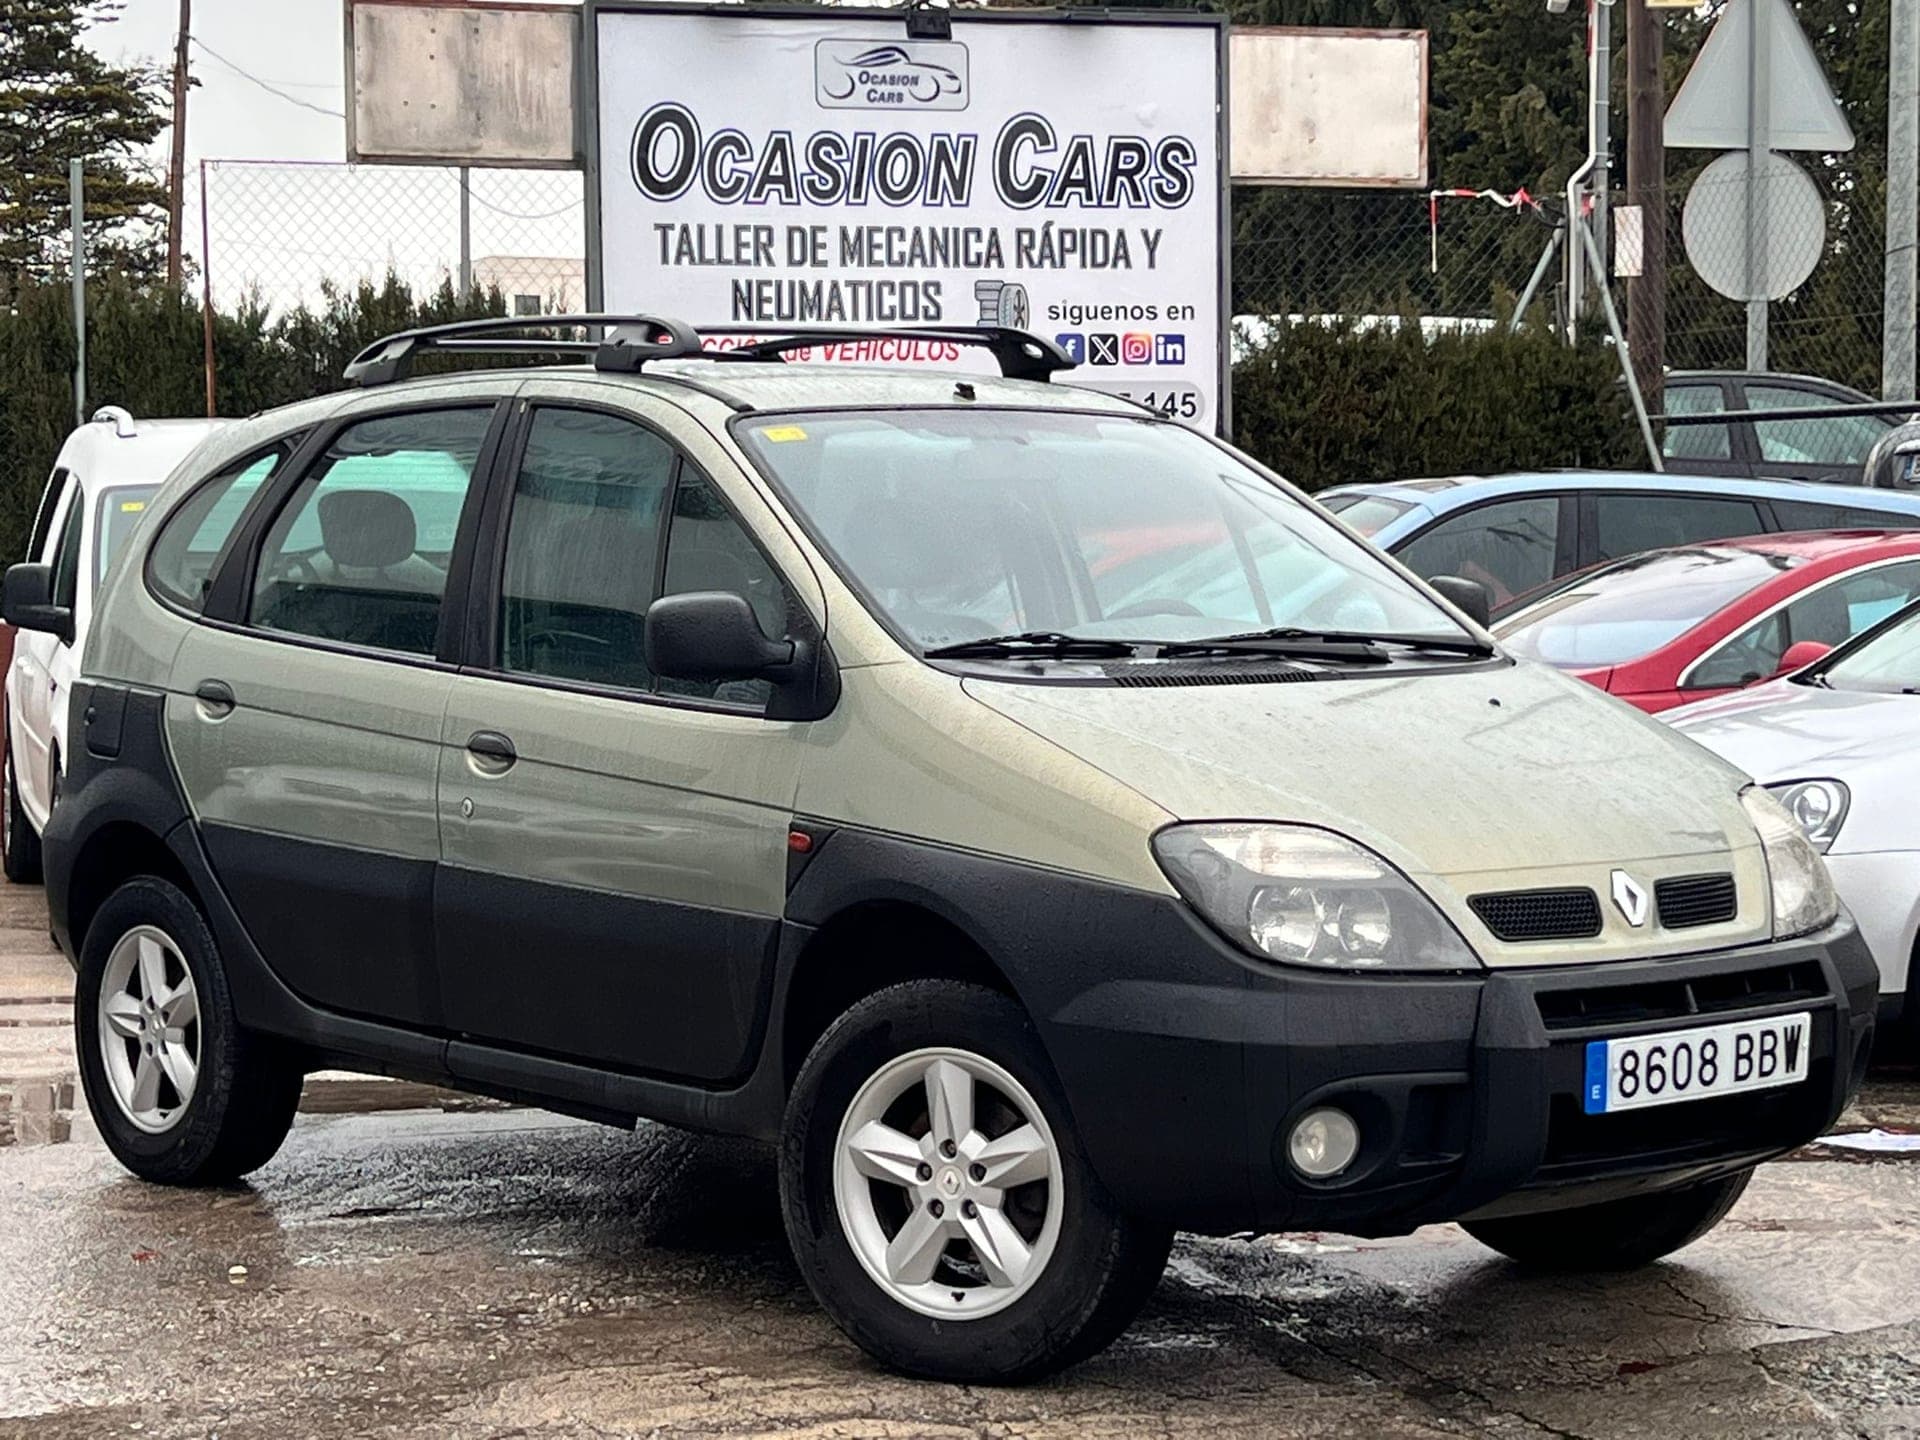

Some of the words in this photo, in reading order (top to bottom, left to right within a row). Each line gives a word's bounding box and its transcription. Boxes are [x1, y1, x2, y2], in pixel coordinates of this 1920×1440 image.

[858, 70, 920, 87] OCASION
[866, 88, 904, 104] CARS
[653, 223, 776, 267] TALLER
[787, 225, 829, 268] DE
[840, 226, 1005, 270] MECANICA
[1015, 220, 1132, 270] RÁPIDA
[1140, 228, 1164, 270] Y
[731, 278, 943, 322] NEUMATICOS
[1166, 304, 1196, 321] en
[1618, 1038, 1718, 1099] 8608
[1733, 1022, 1803, 1082] BBW
